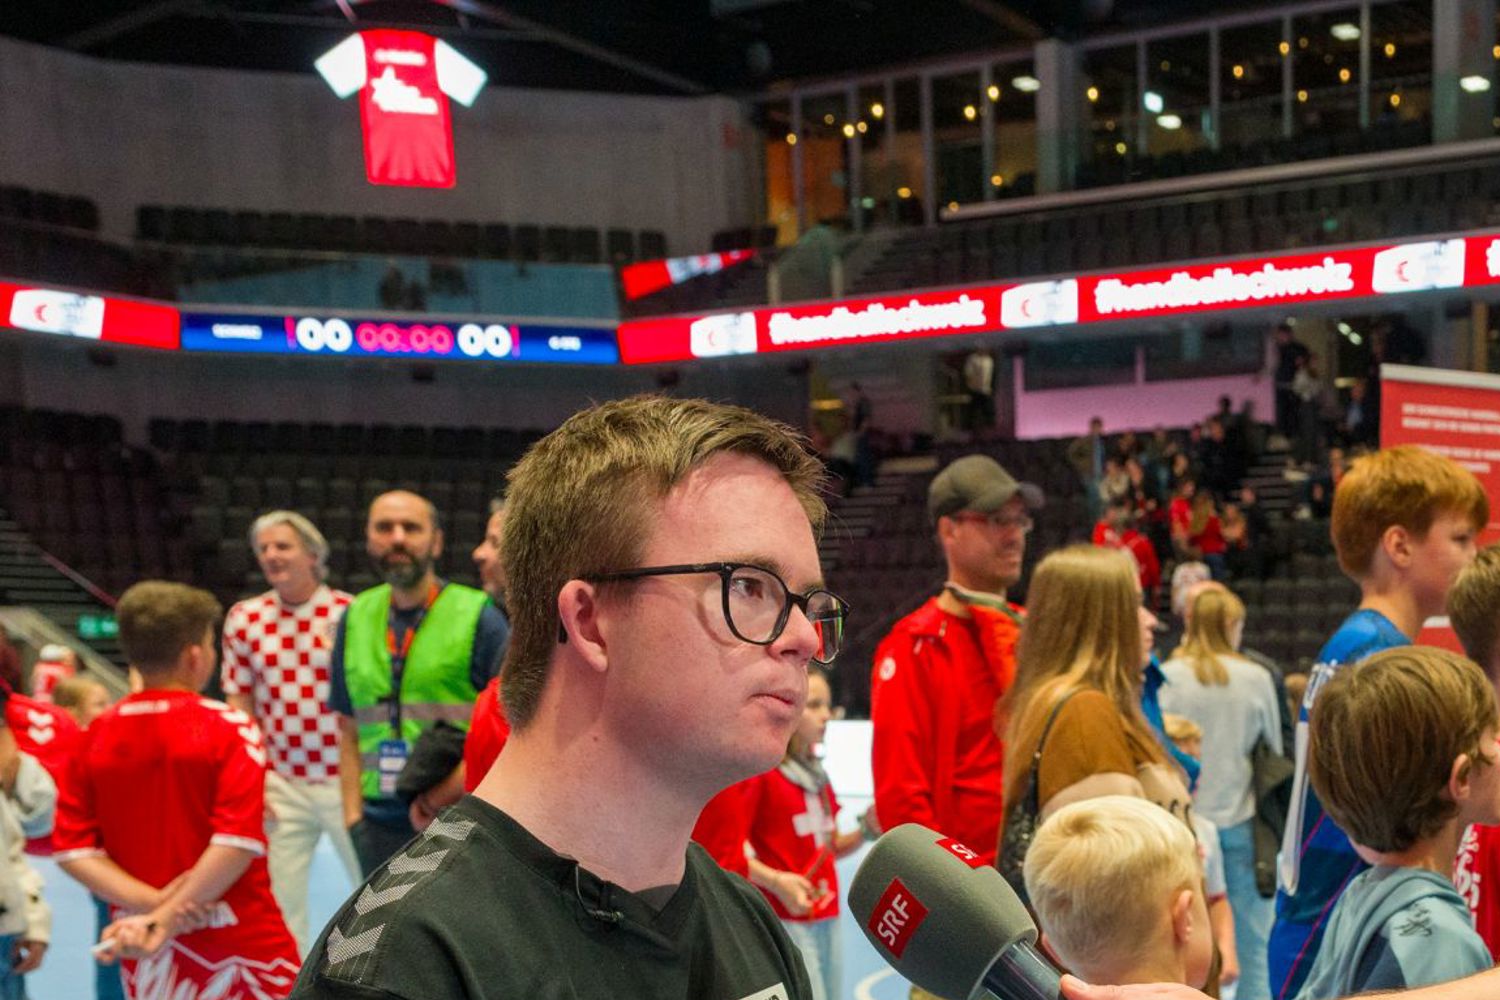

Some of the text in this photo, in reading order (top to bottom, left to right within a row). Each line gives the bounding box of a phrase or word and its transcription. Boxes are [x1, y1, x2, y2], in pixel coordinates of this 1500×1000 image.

[296, 317, 353, 352] 00
[457, 323, 513, 358] 00
[877, 893, 910, 946] SRF
